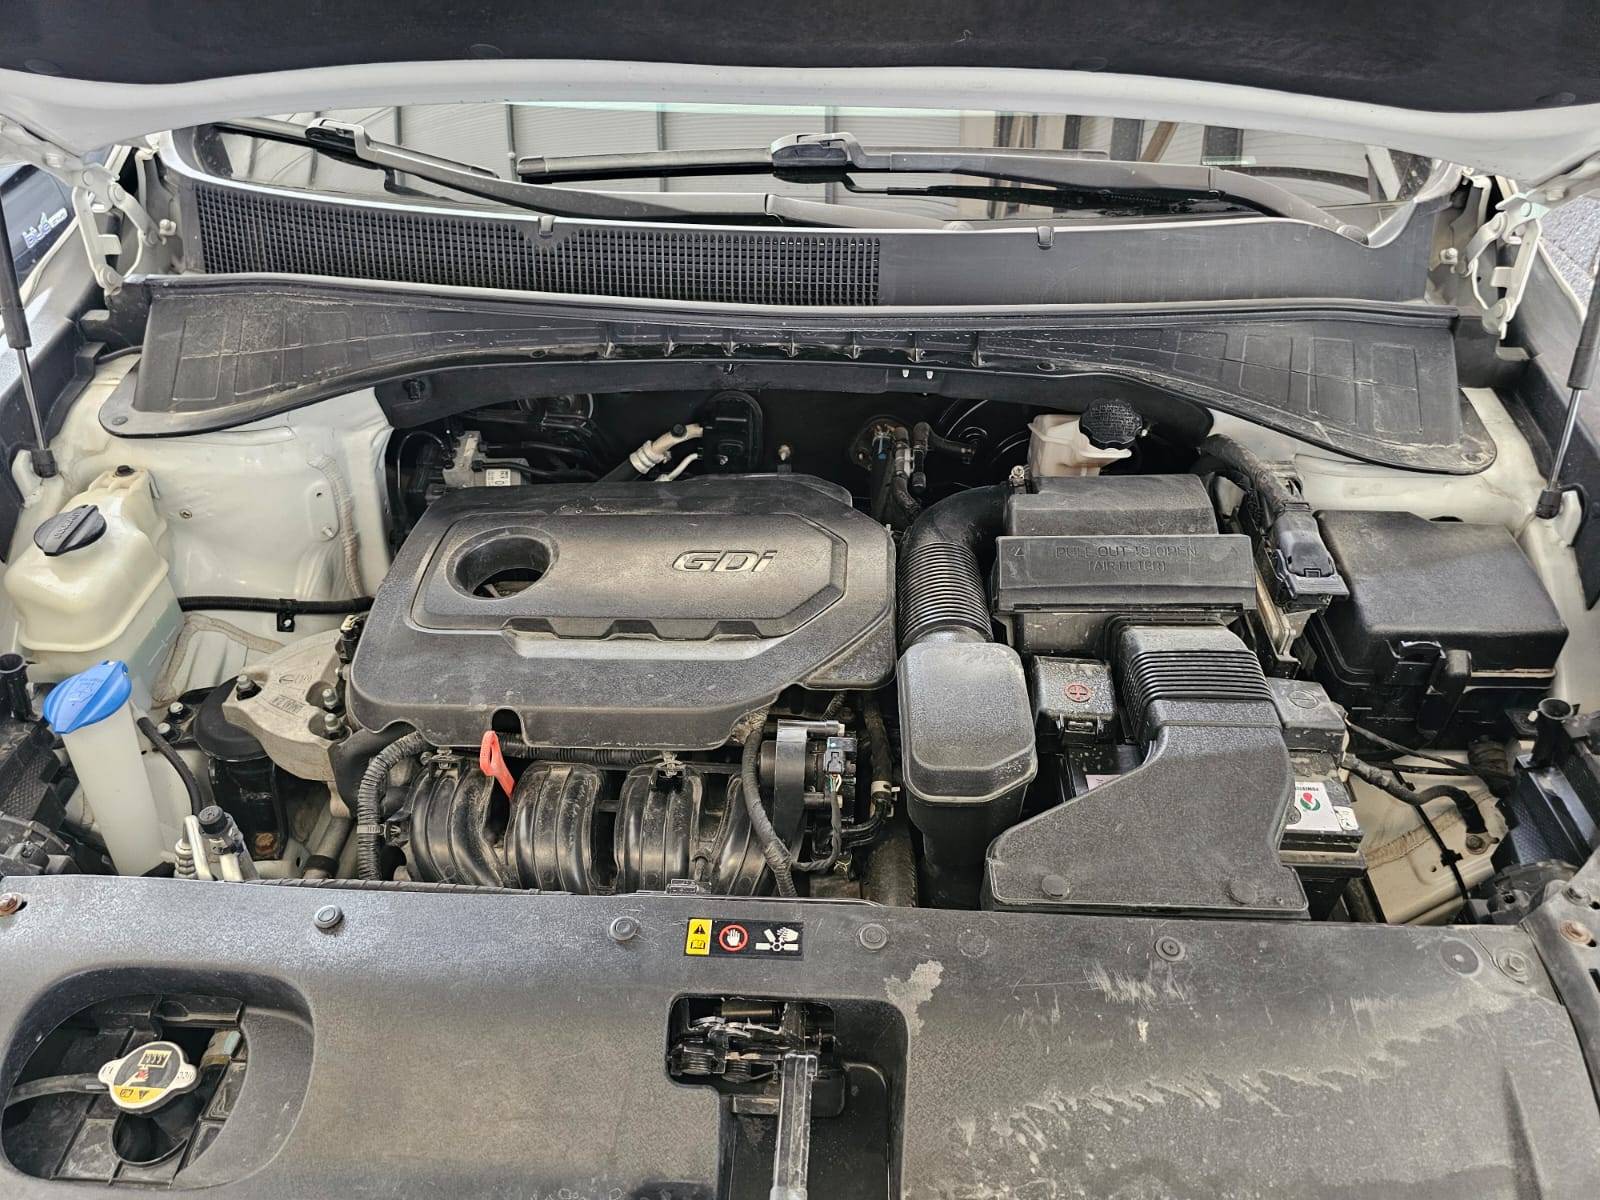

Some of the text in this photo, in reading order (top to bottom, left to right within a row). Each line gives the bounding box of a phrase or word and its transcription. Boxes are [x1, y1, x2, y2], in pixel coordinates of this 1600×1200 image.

[1056, 546, 1089, 559] PULL
[1098, 545, 1127, 558] OUT
[1155, 545, 1197, 559] OPEN
[672, 550, 778, 572] GDi
[1088, 560, 1116, 573] (AIR
